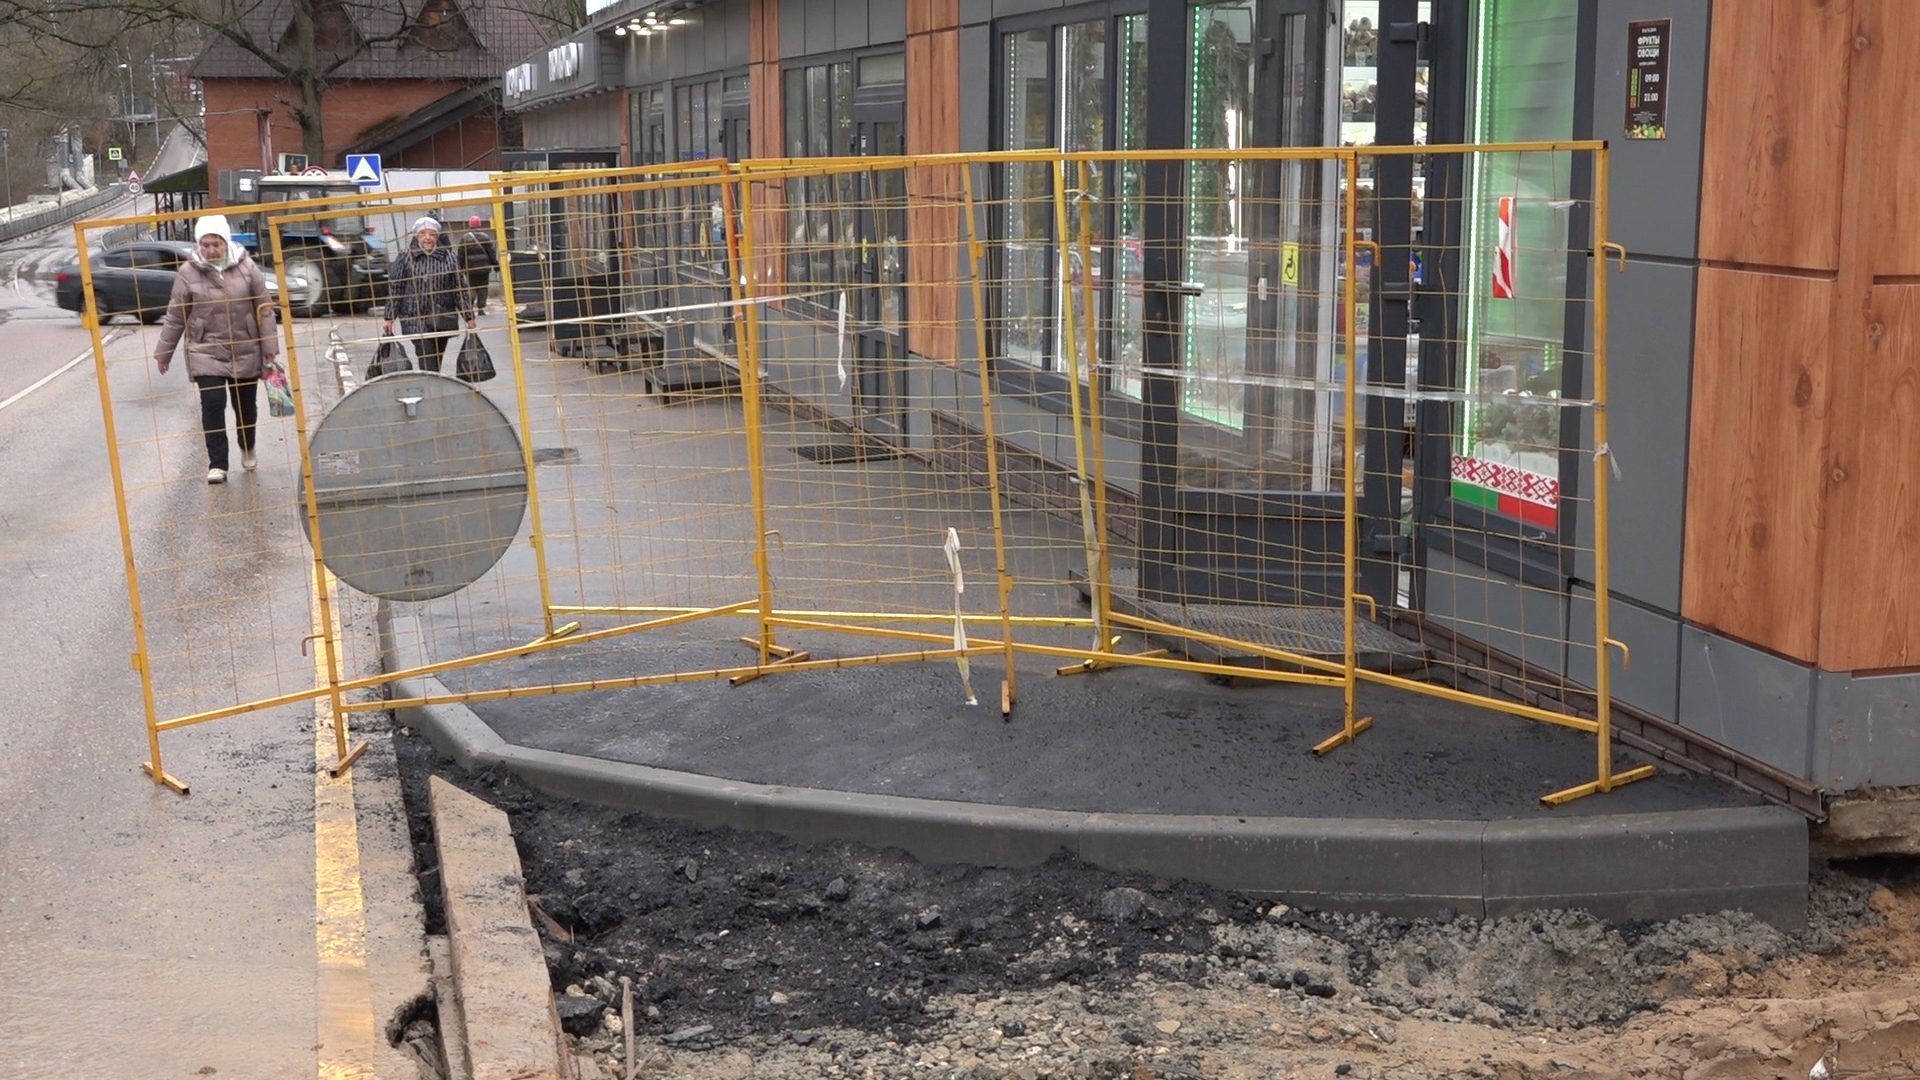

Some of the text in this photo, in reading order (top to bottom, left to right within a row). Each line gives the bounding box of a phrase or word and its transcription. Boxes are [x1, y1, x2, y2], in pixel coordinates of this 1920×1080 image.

[1638, 35, 1660, 45] ФРУКТЫ
[1637, 48, 1659, 58] ОВОЩИ
[1645, 74, 1659, 83] 09:00
[1644, 93, 1658, 101] 21:00
